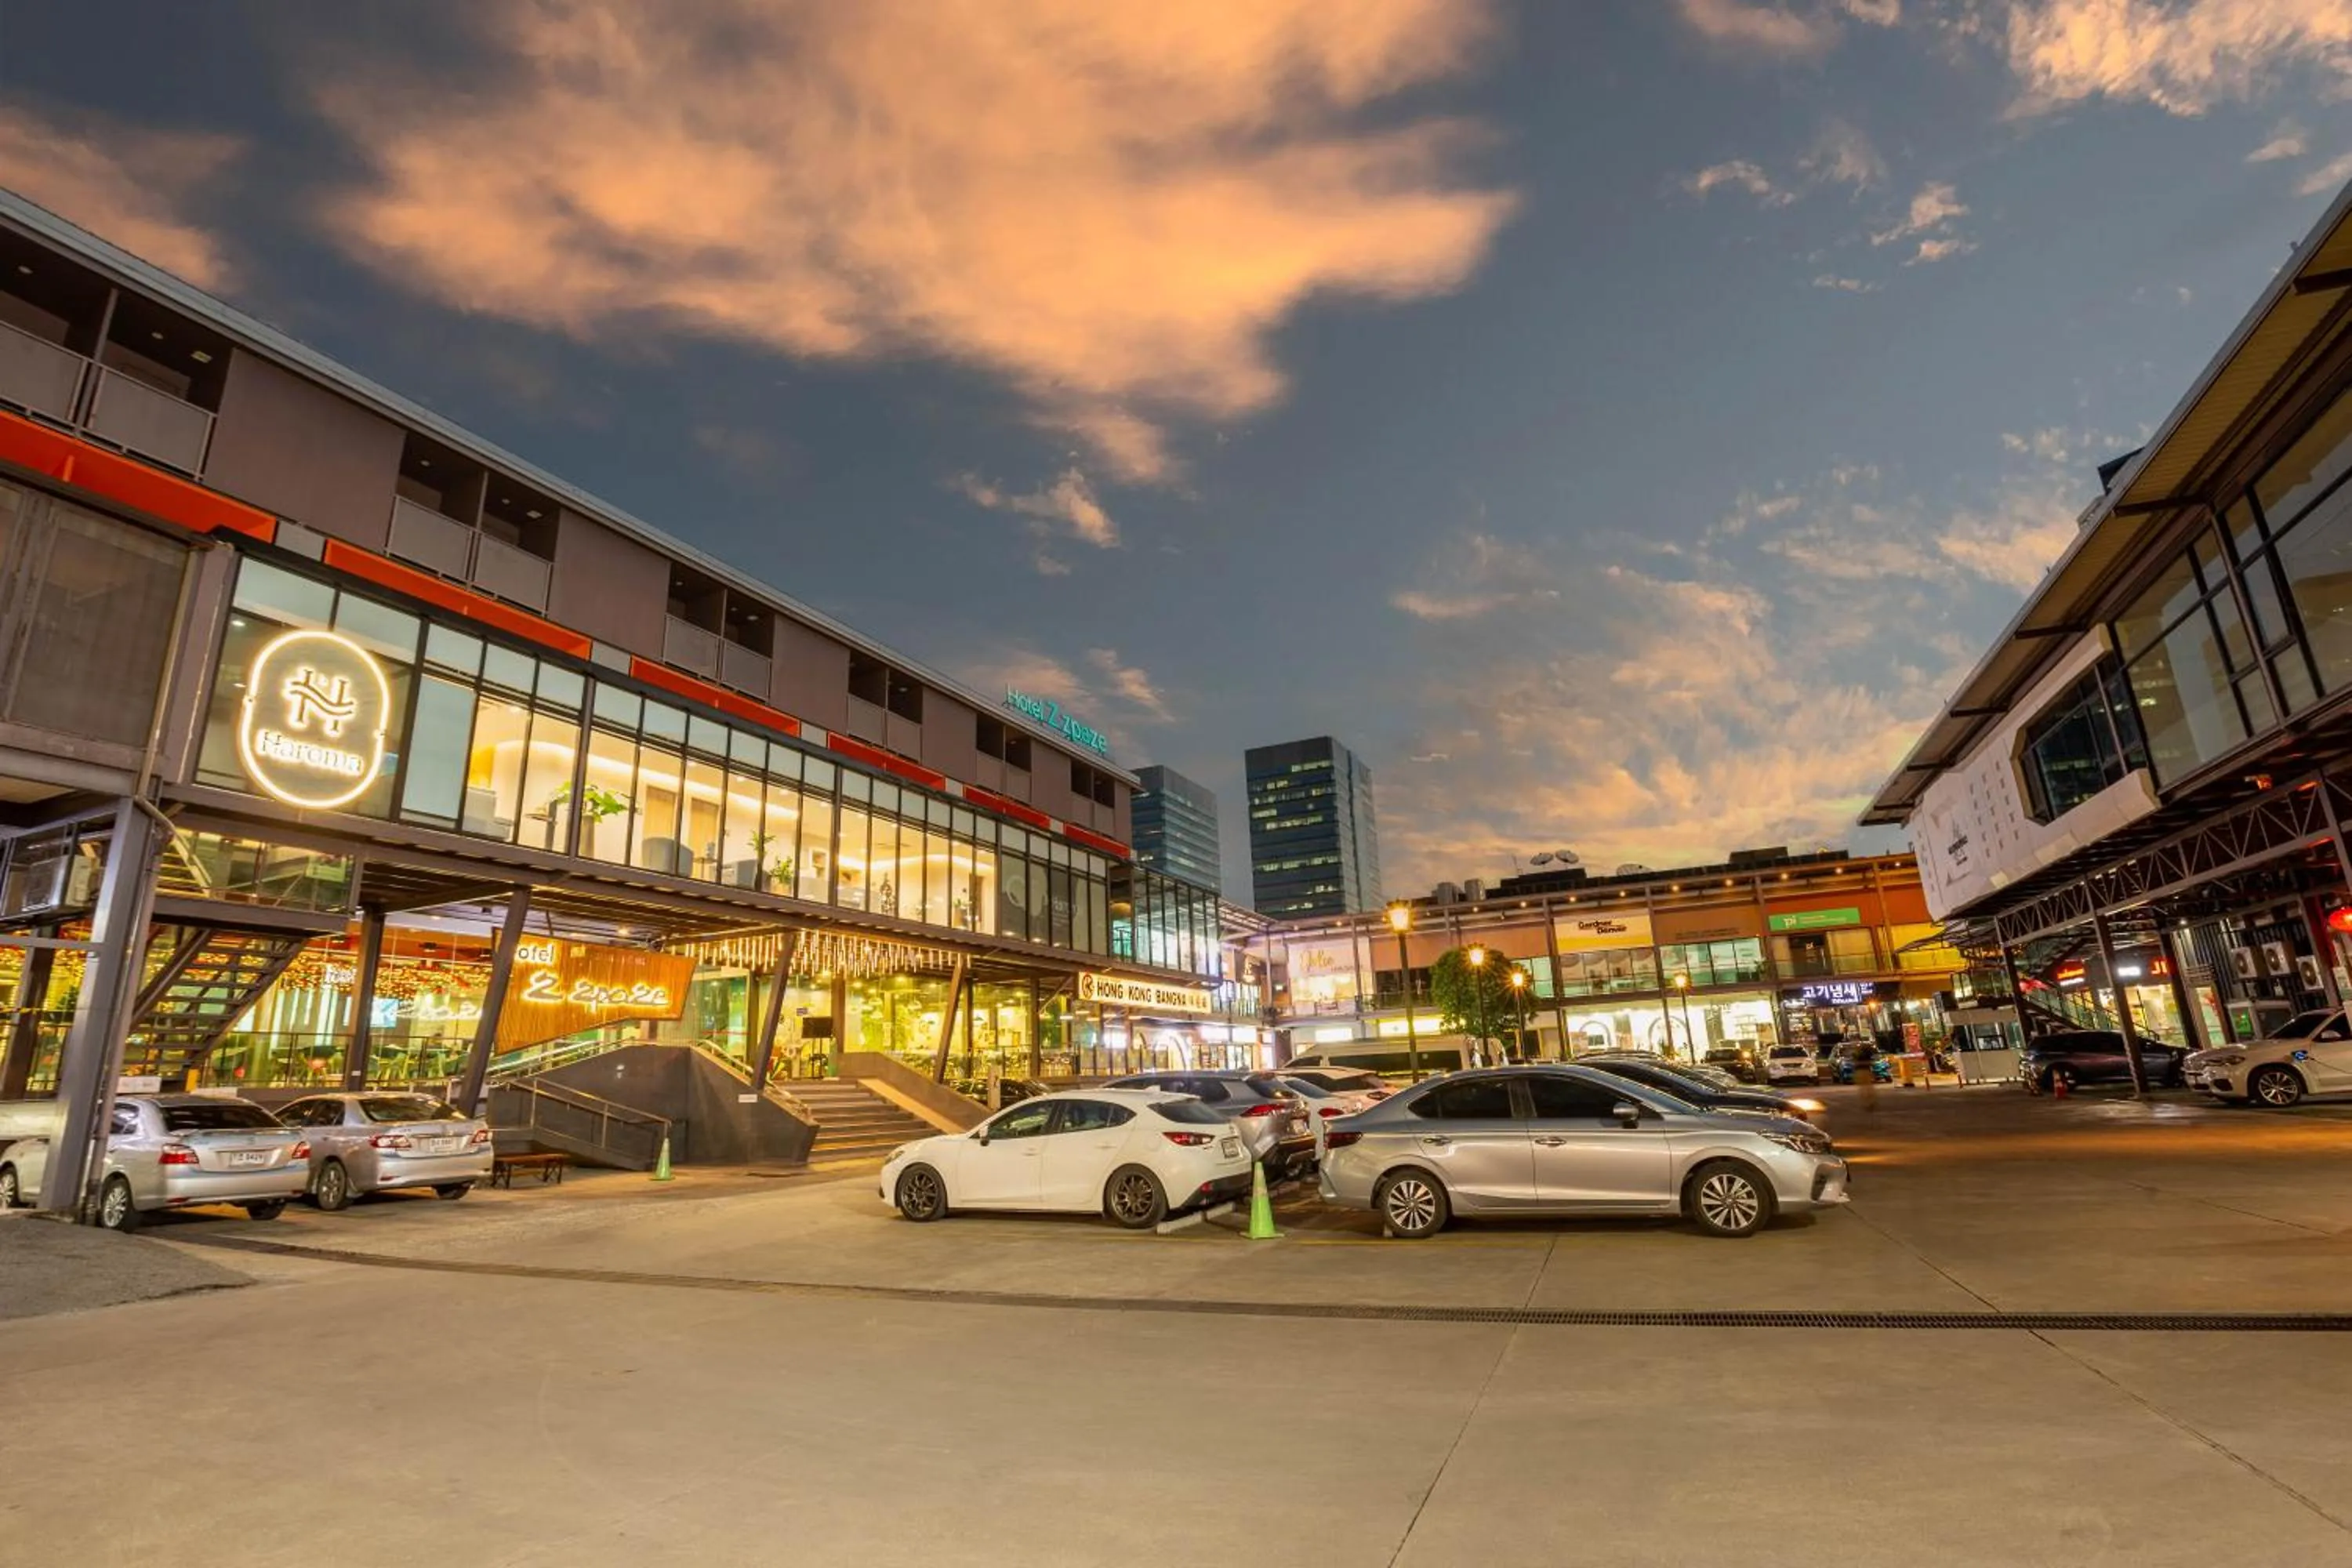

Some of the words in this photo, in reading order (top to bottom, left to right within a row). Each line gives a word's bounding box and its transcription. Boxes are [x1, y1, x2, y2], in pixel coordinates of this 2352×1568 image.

[1007, 682, 1044, 720] Hotel
[260, 730, 364, 773] Haroma
[517, 943, 554, 964] otel
[1097, 980, 1123, 1000] HONG
[1128, 985, 1152, 1003] KONG
[1156, 989, 1186, 1006] BANGNA
